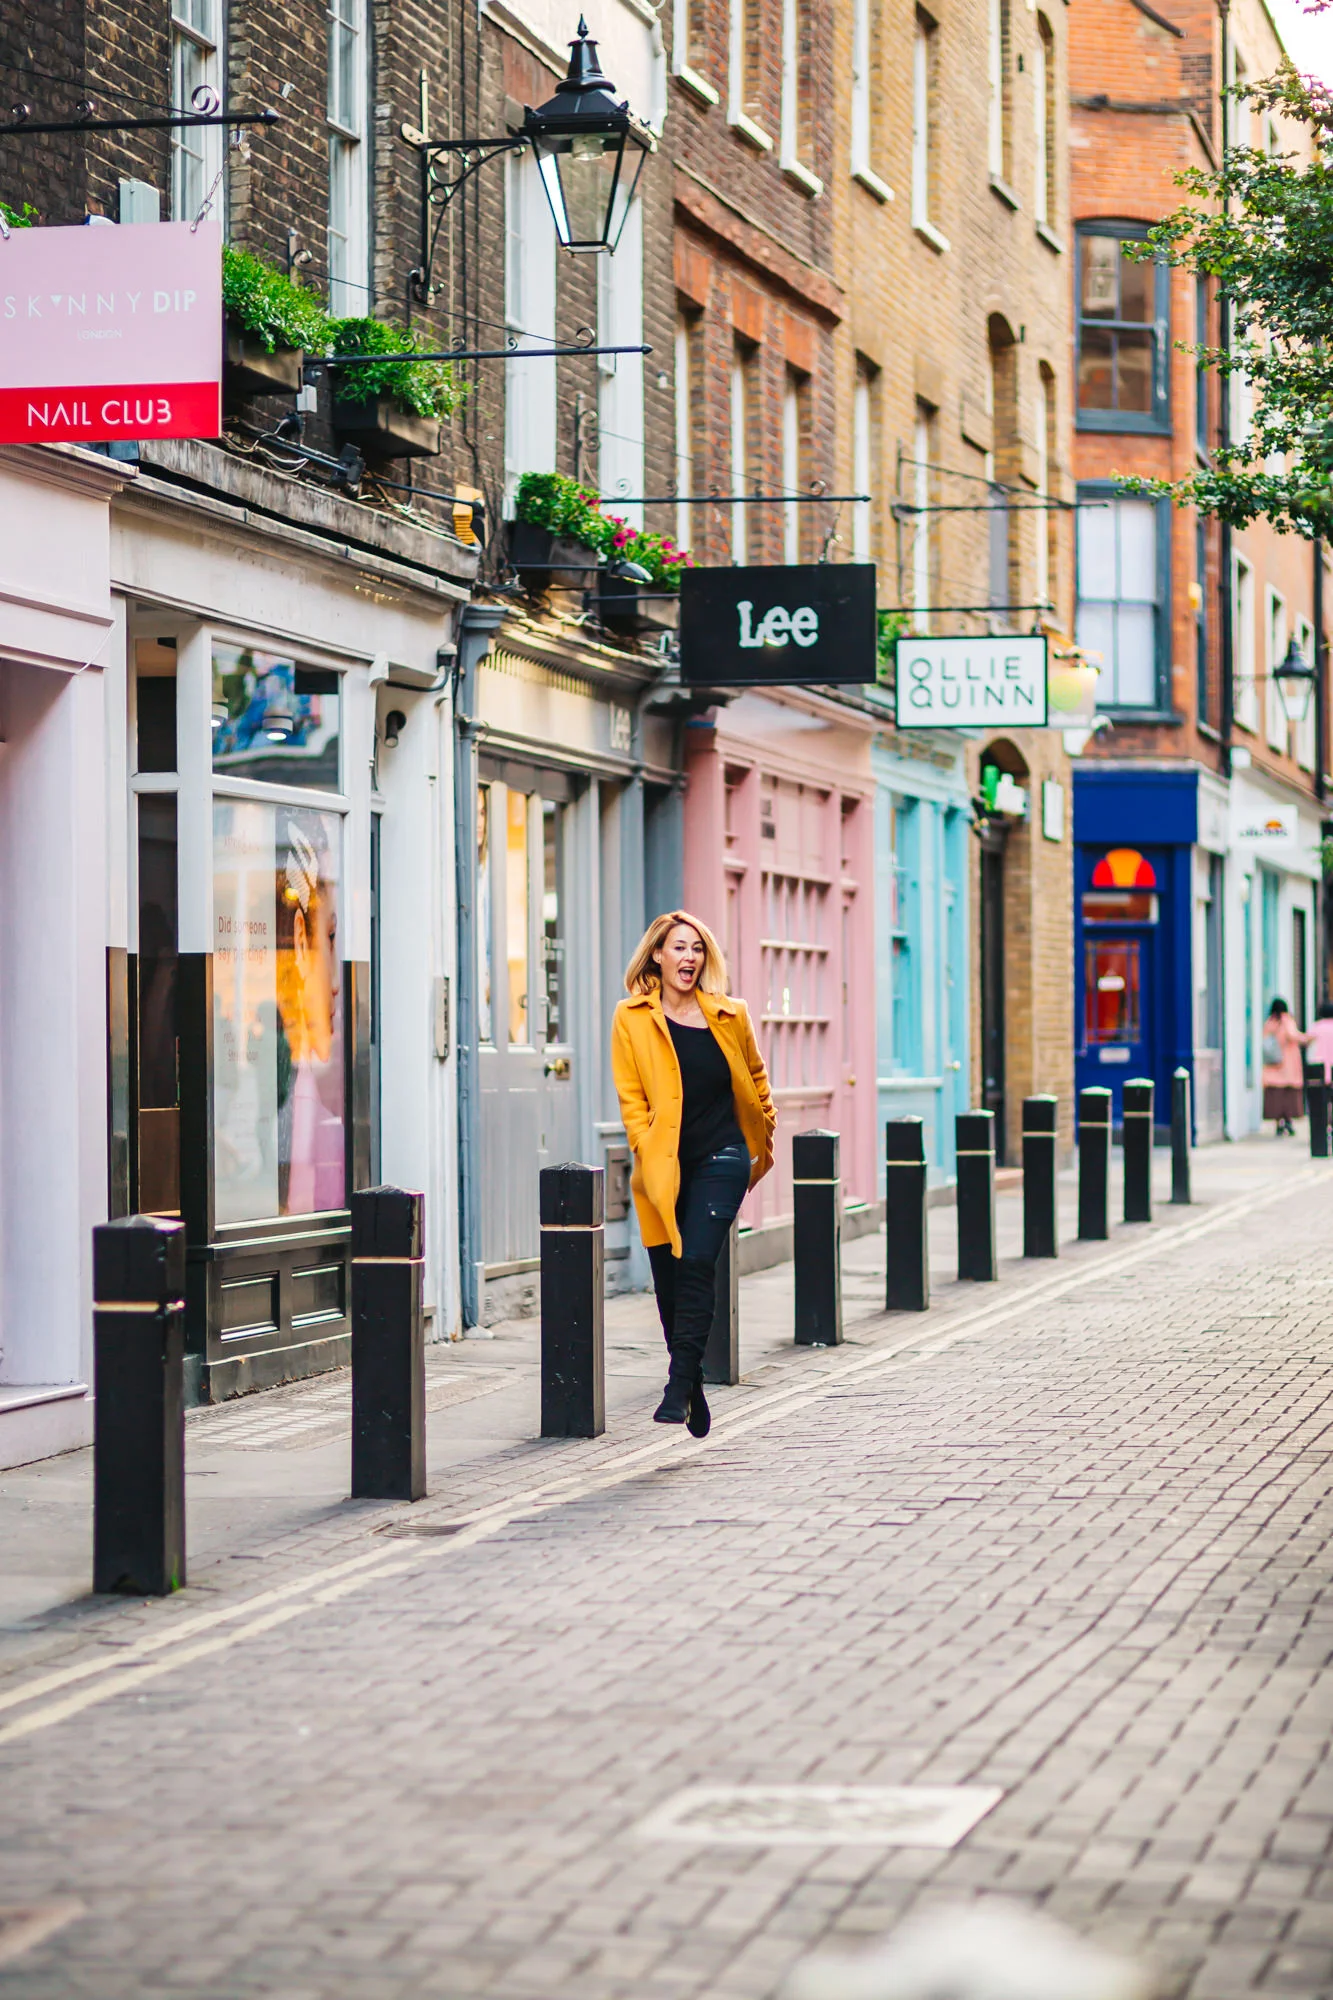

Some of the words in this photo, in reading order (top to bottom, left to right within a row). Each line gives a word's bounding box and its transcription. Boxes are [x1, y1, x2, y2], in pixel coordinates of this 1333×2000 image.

[153, 289, 197, 315] DIP
[77, 329, 123, 341] LONDON
[27, 401, 92, 427] NAIL
[101, 398, 172, 425] CLUB
[736, 600, 819, 648] Lee
[909, 656, 1021, 681] OLLIE
[909, 684, 1034, 709] QUINN
[218, 915, 231, 934] Did
[234, 945, 267, 966] pcing?
